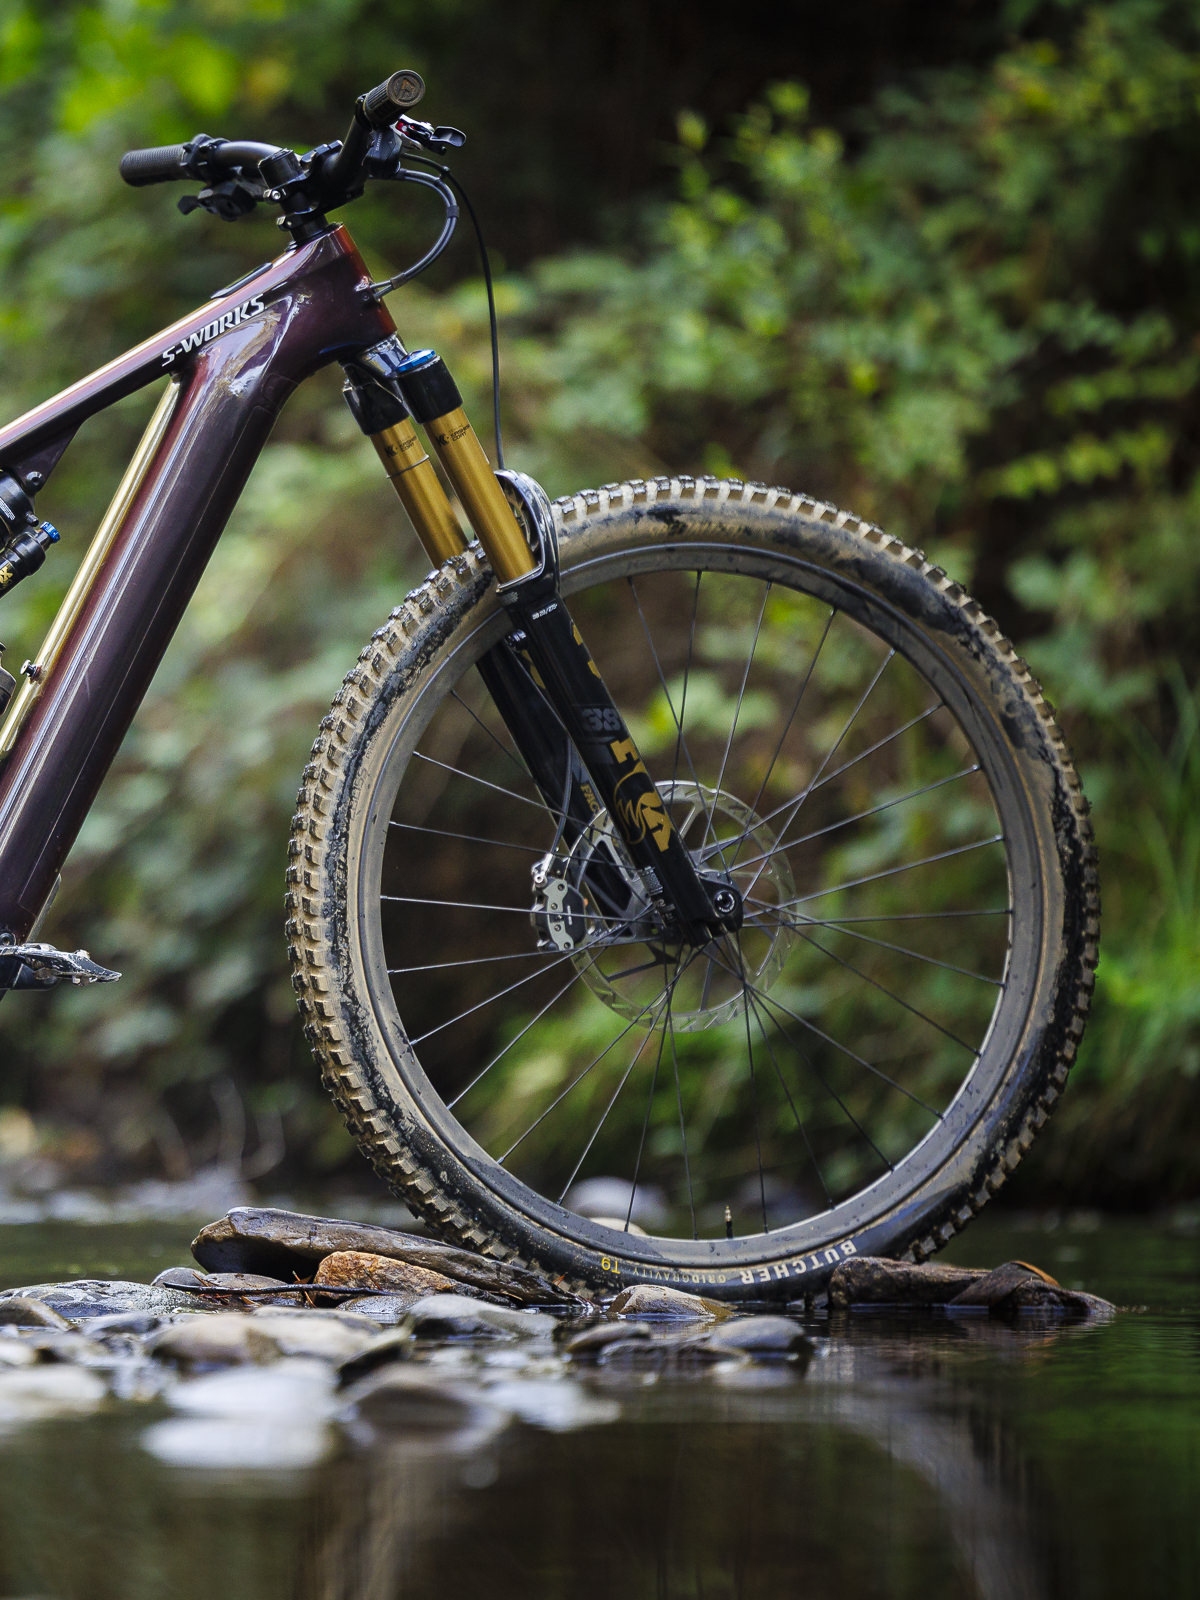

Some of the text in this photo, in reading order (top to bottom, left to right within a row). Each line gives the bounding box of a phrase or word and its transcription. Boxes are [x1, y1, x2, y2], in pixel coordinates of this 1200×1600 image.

[161, 293, 267, 367] S-WORKS
[582, 707, 622, 731] 38
[601, 1257, 621, 1275] T9
[740, 1240, 857, 1285] BUTCHER
